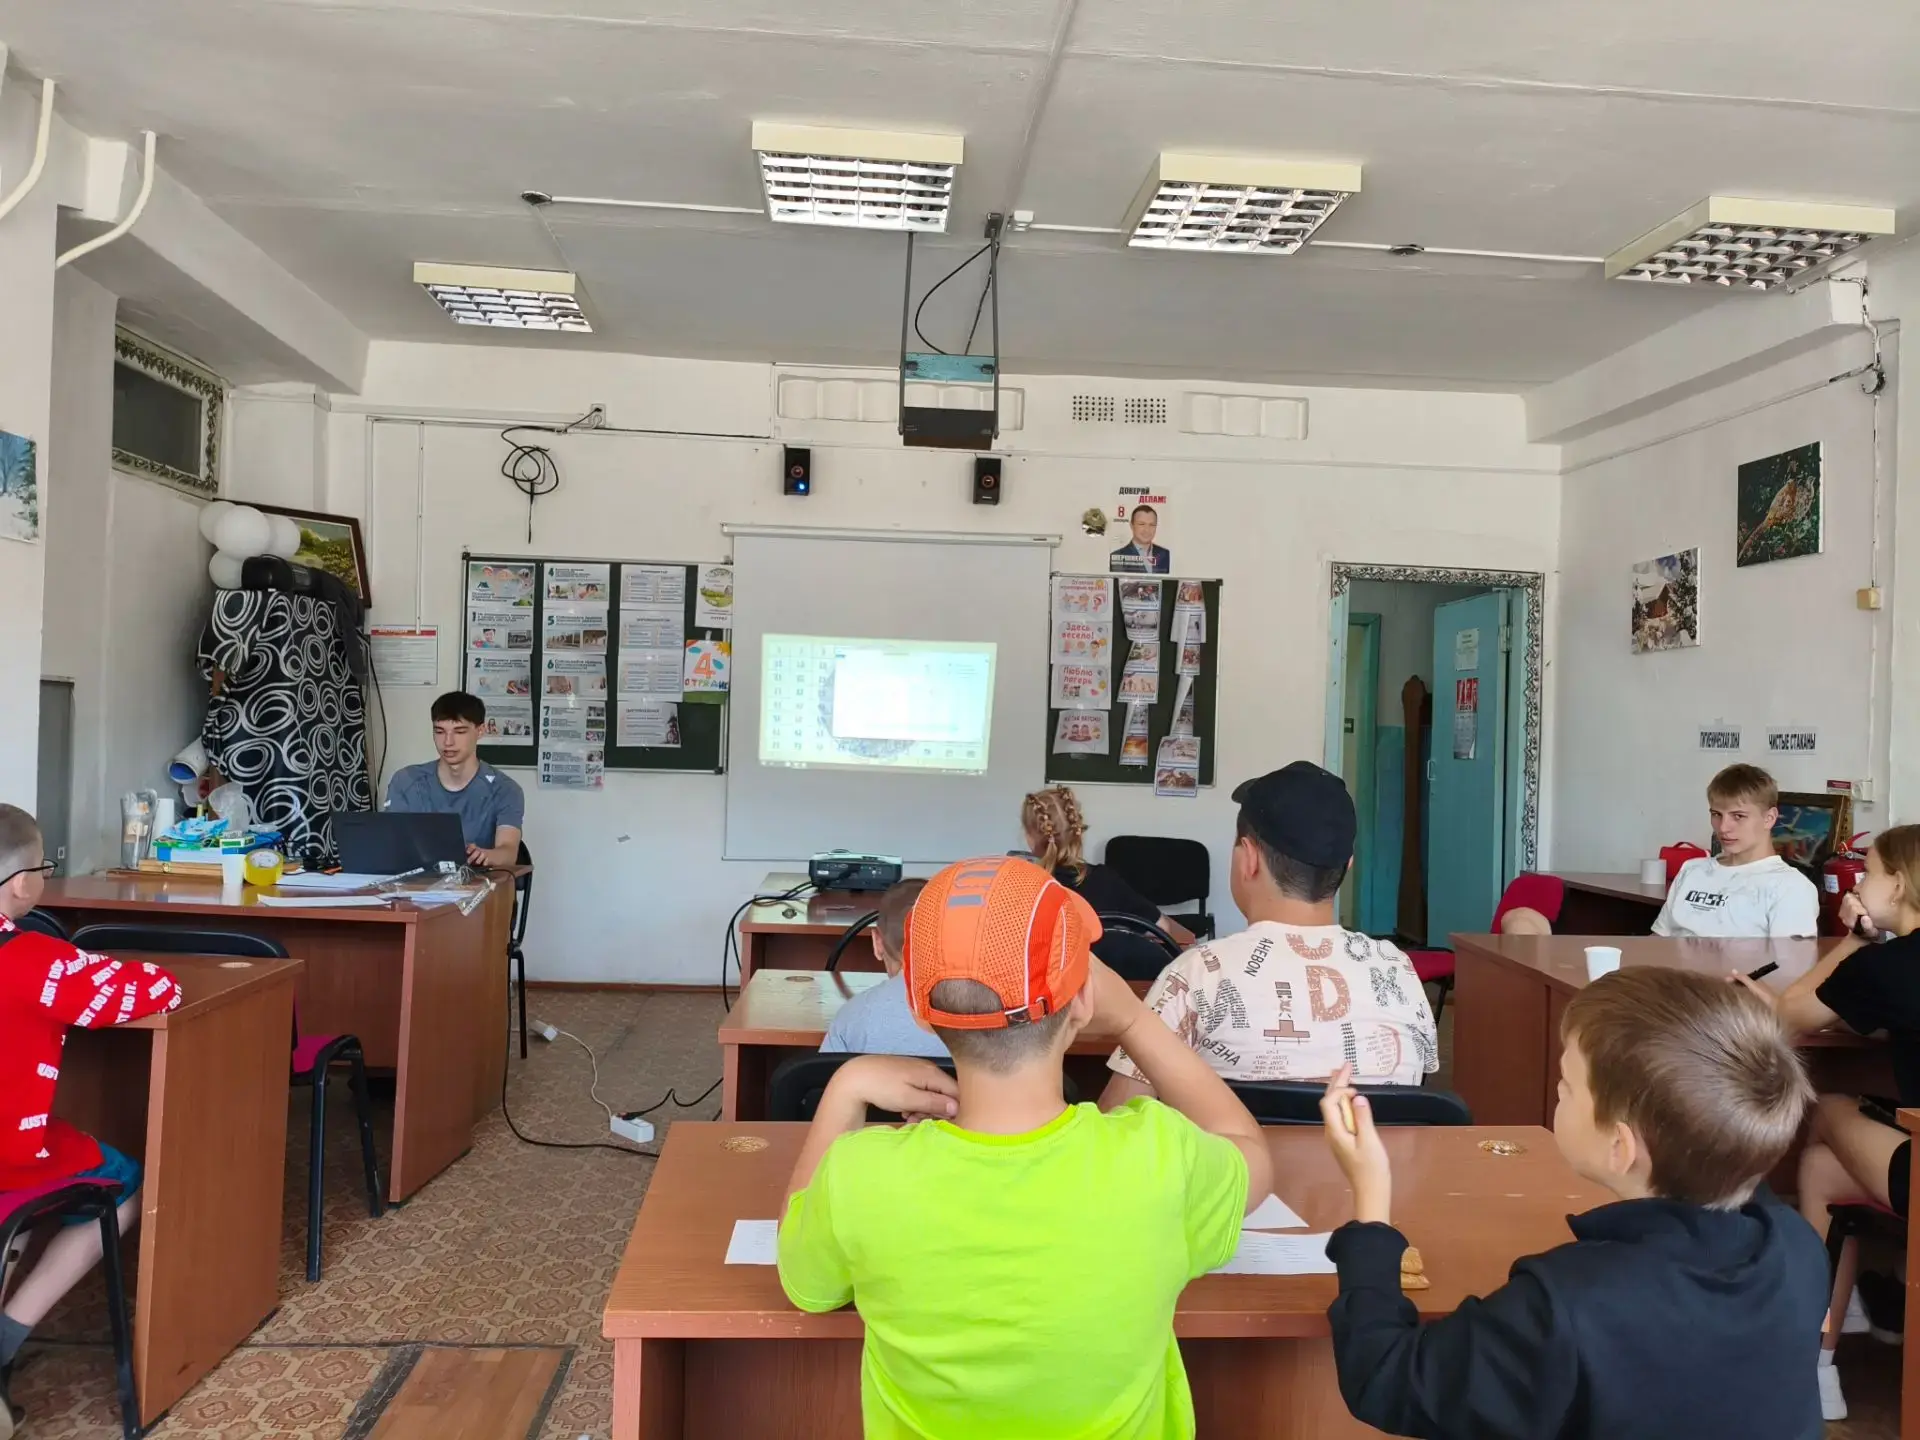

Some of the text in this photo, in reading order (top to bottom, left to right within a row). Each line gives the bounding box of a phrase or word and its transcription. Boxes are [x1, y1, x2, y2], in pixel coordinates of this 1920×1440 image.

[1119, 486, 1150, 495] ДОВЕРЯЙ
[1139, 496, 1166, 504] ДЕЛАМ!
[547, 615, 555, 626] 5
[1066, 622, 1090, 632] Здесь
[474, 657, 482, 668] 2
[547, 659, 555, 670] 6
[692, 652, 716, 679] 4
[542, 706, 550, 715] 7
[542, 729, 550, 739] 9
[1768, 733, 1816, 750] ЧИСТЫЕ СТАКАНЫ
[542, 751, 552, 760] 10
[542, 774, 551, 783] 12
[1244, 937, 1274, 977] AHEBON
[91, 966, 116, 987] JUST
[40, 979, 58, 1007] JUST
[89, 994, 108, 1011] DO
[1199, 1037, 1241, 1066] AHEBO
[19, 1113, 48, 1131] JUST
